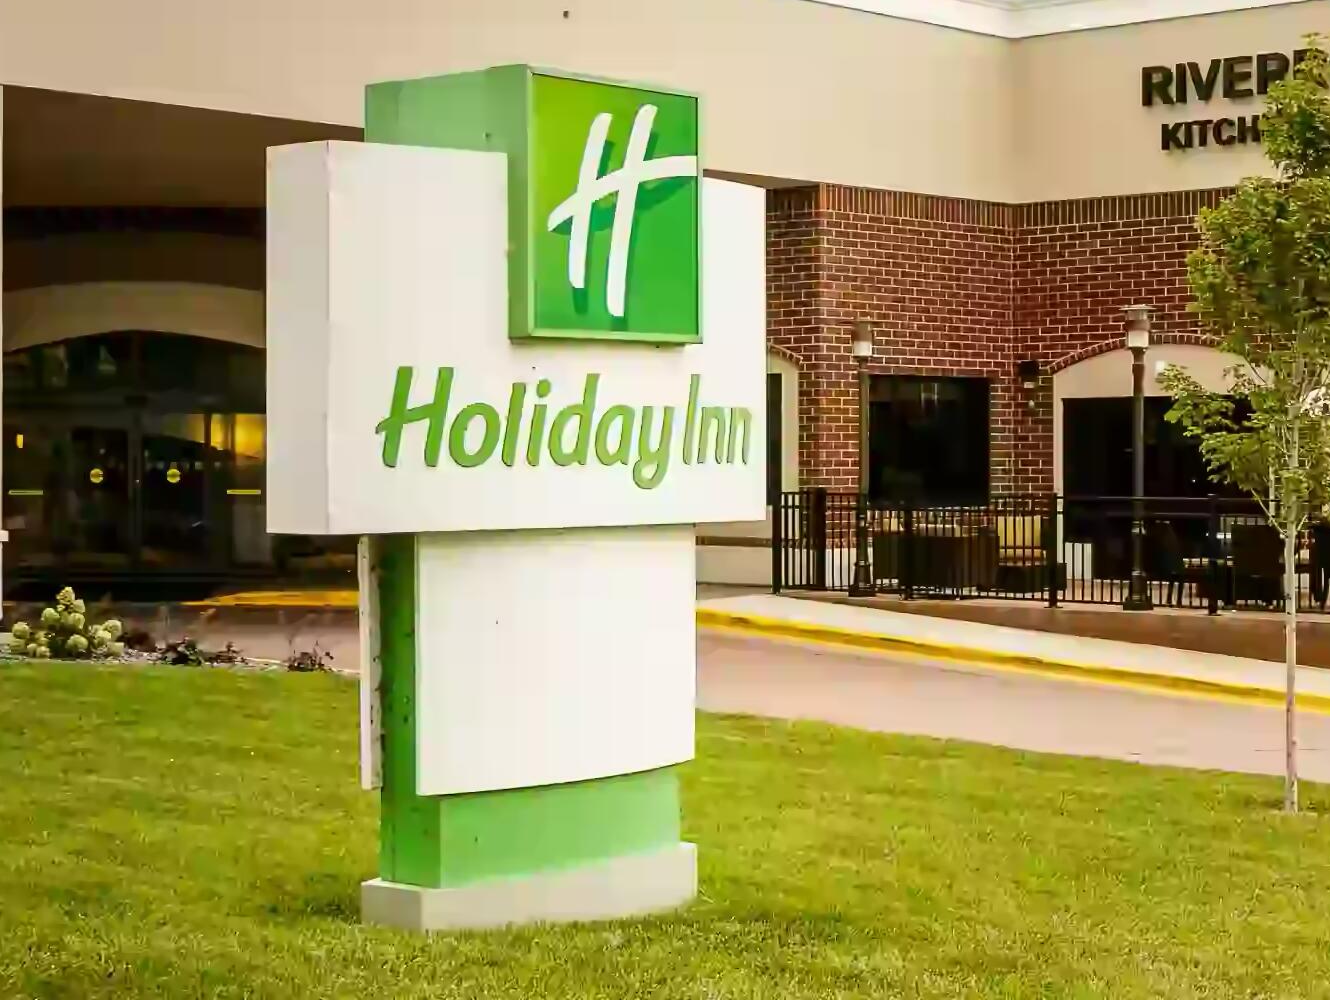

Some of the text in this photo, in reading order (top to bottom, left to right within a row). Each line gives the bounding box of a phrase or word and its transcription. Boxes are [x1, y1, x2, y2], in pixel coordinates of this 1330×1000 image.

[1161, 109, 1296, 151] KITCH
[375, 366, 753, 490] Holiday Inn
